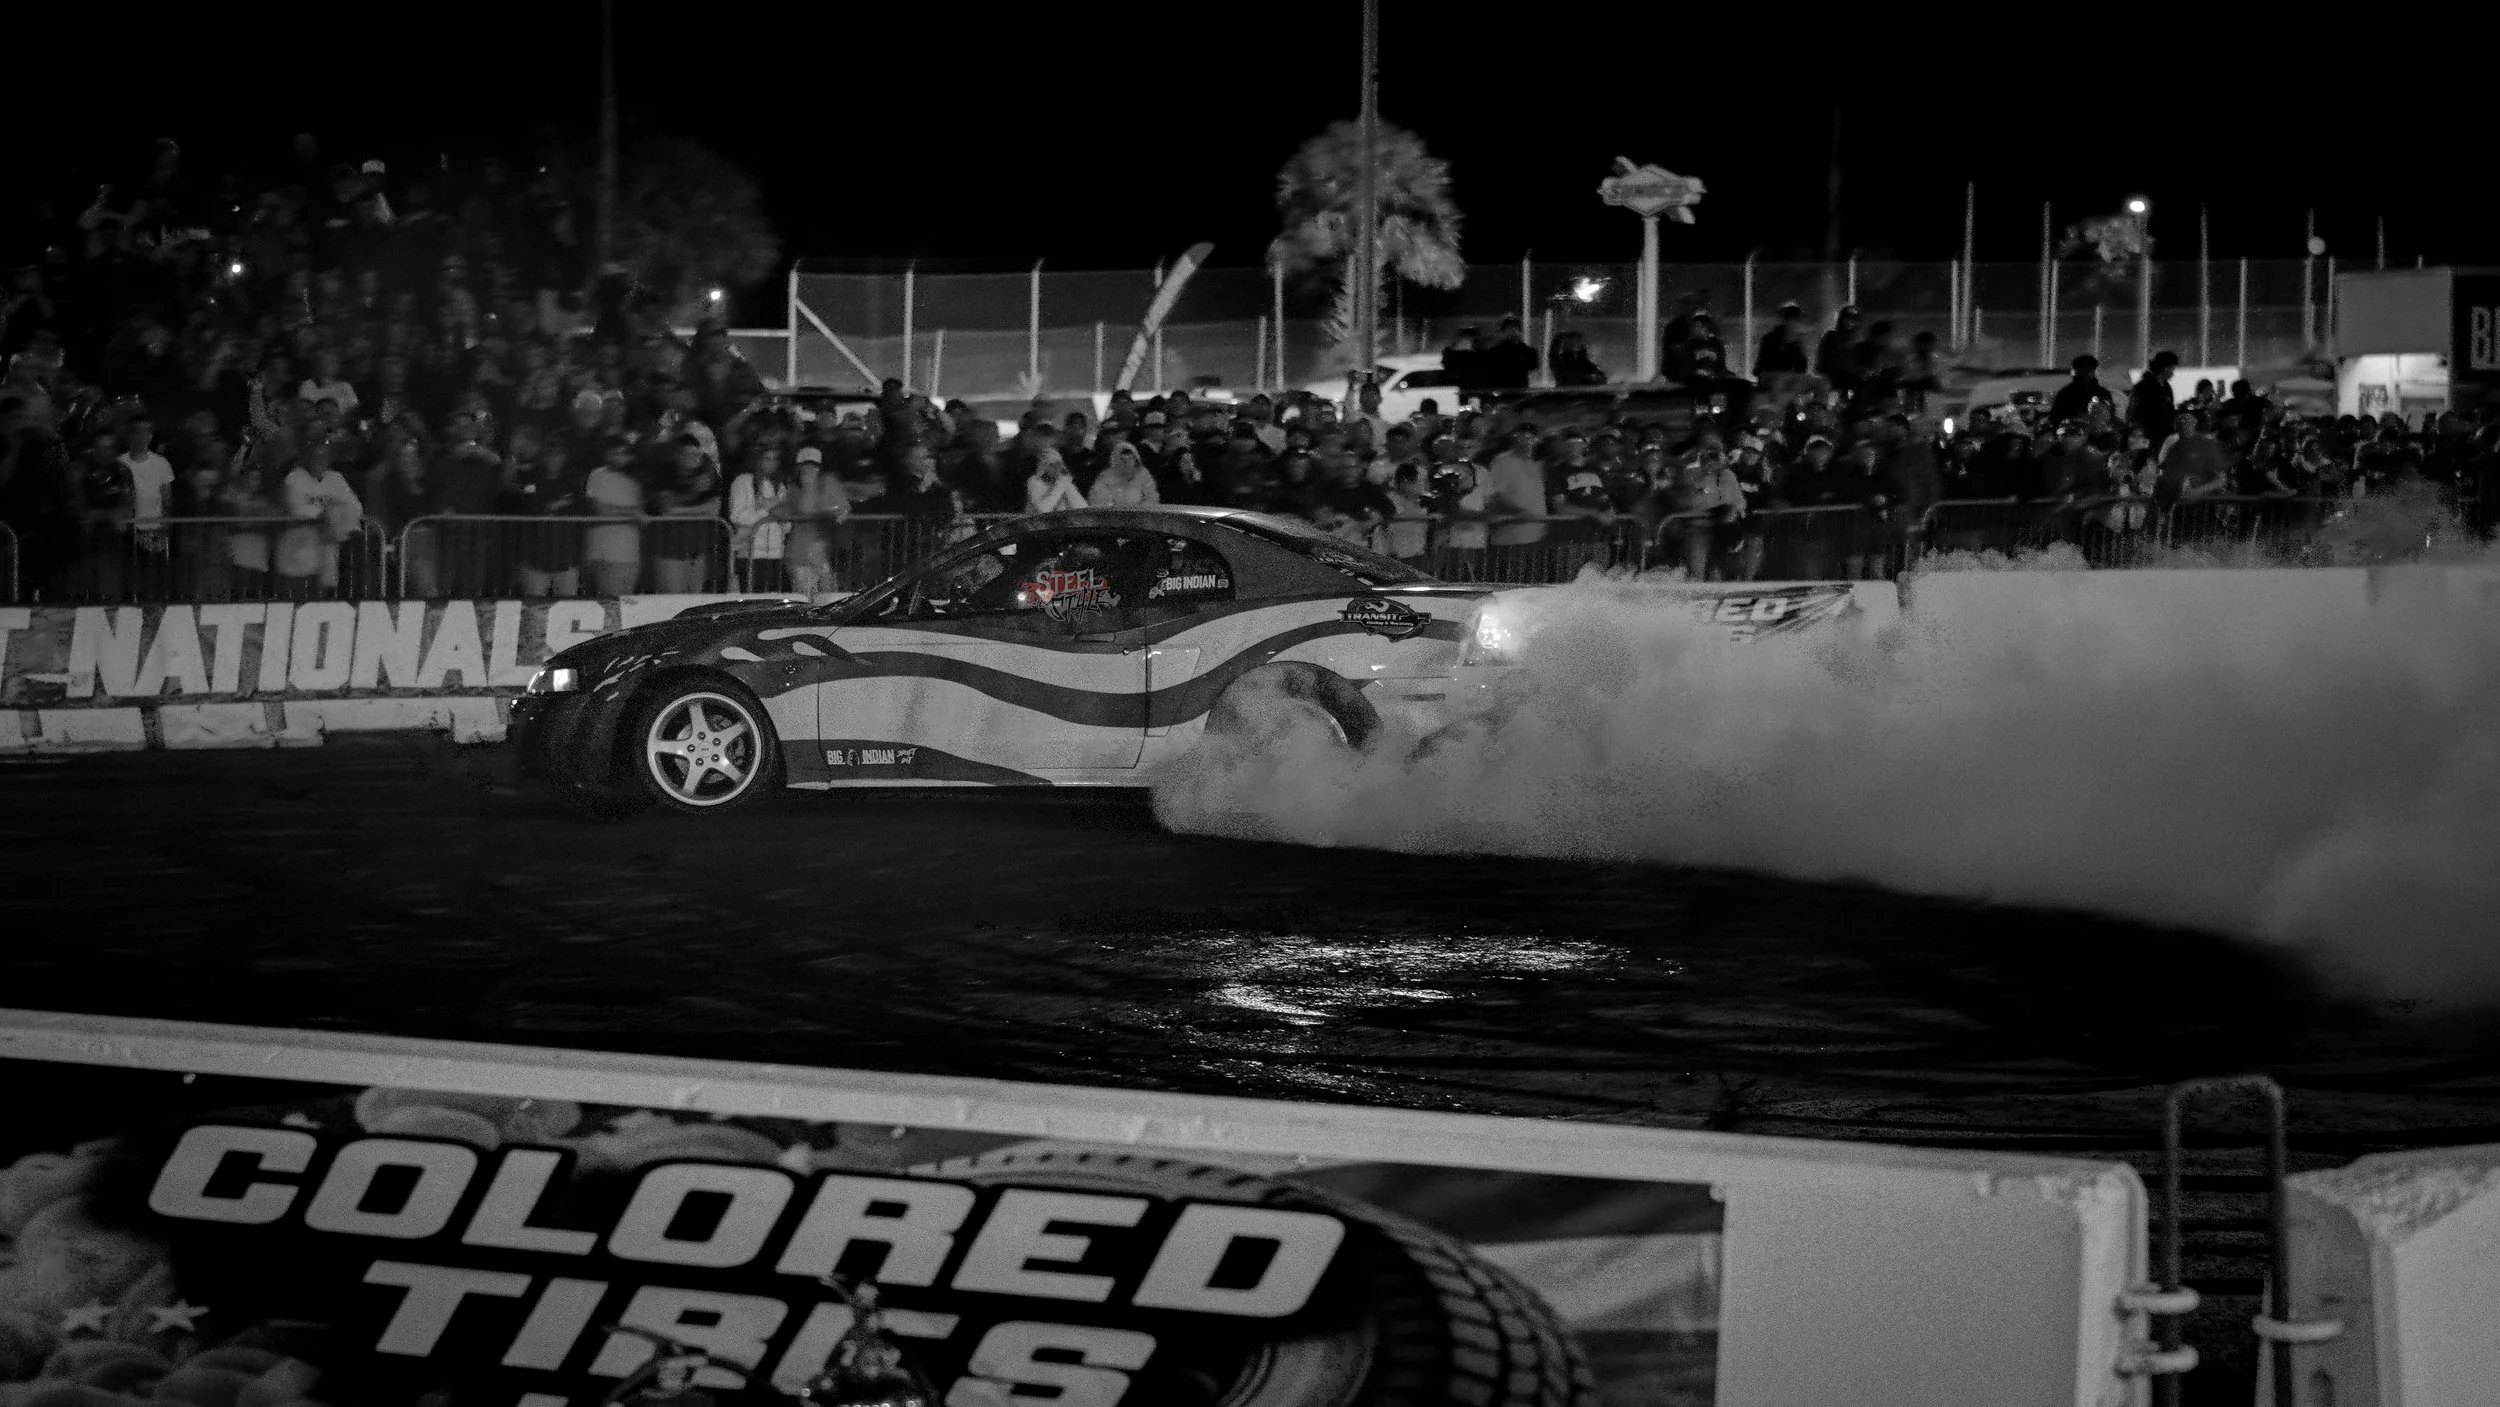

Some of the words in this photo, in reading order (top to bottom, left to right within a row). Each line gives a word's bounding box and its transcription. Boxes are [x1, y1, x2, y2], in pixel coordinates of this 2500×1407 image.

[1036, 567, 1105, 596] STEEL
[1166, 577, 1182, 590] BIG
[1183, 574, 1216, 589] INDIAN
[827, 750, 845, 765] BIG
[862, 749, 895, 764] INDIAN
[148, 1124, 1346, 1319] COLORED
